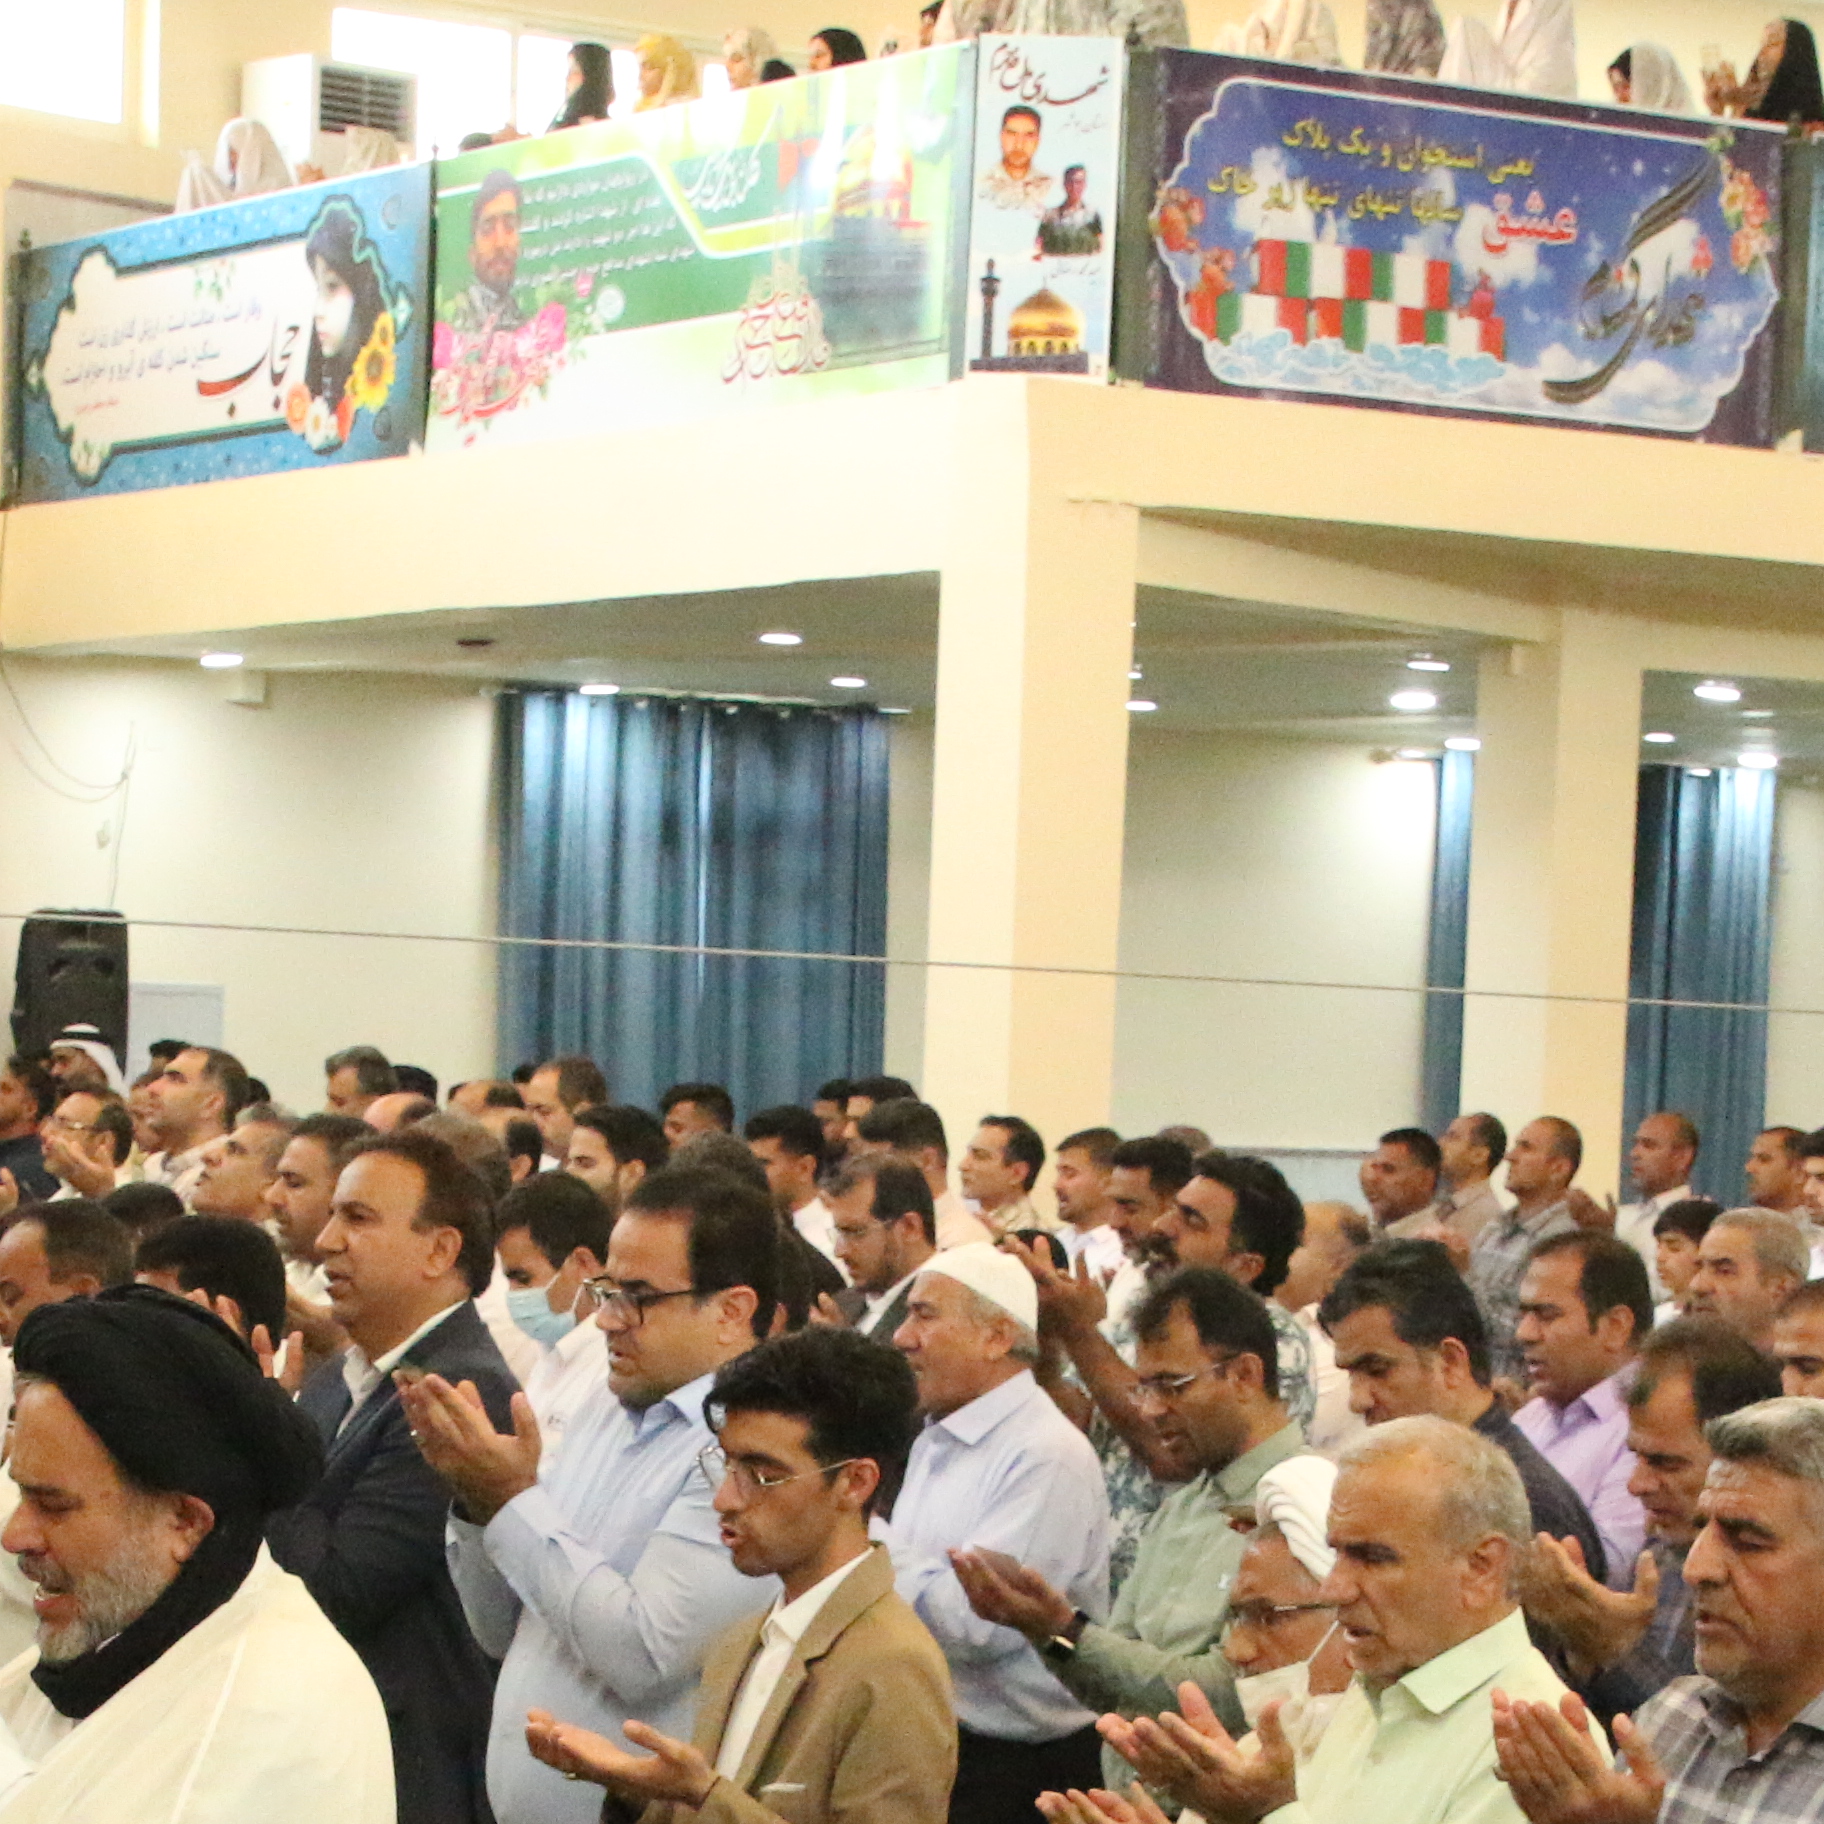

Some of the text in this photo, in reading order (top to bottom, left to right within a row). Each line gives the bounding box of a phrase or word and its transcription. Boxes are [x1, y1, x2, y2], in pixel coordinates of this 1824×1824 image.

[1398, 137, 1484, 172] استخوان
[1481, 189, 1578, 253] عشق
[196, 312, 302, 419] حجاب
